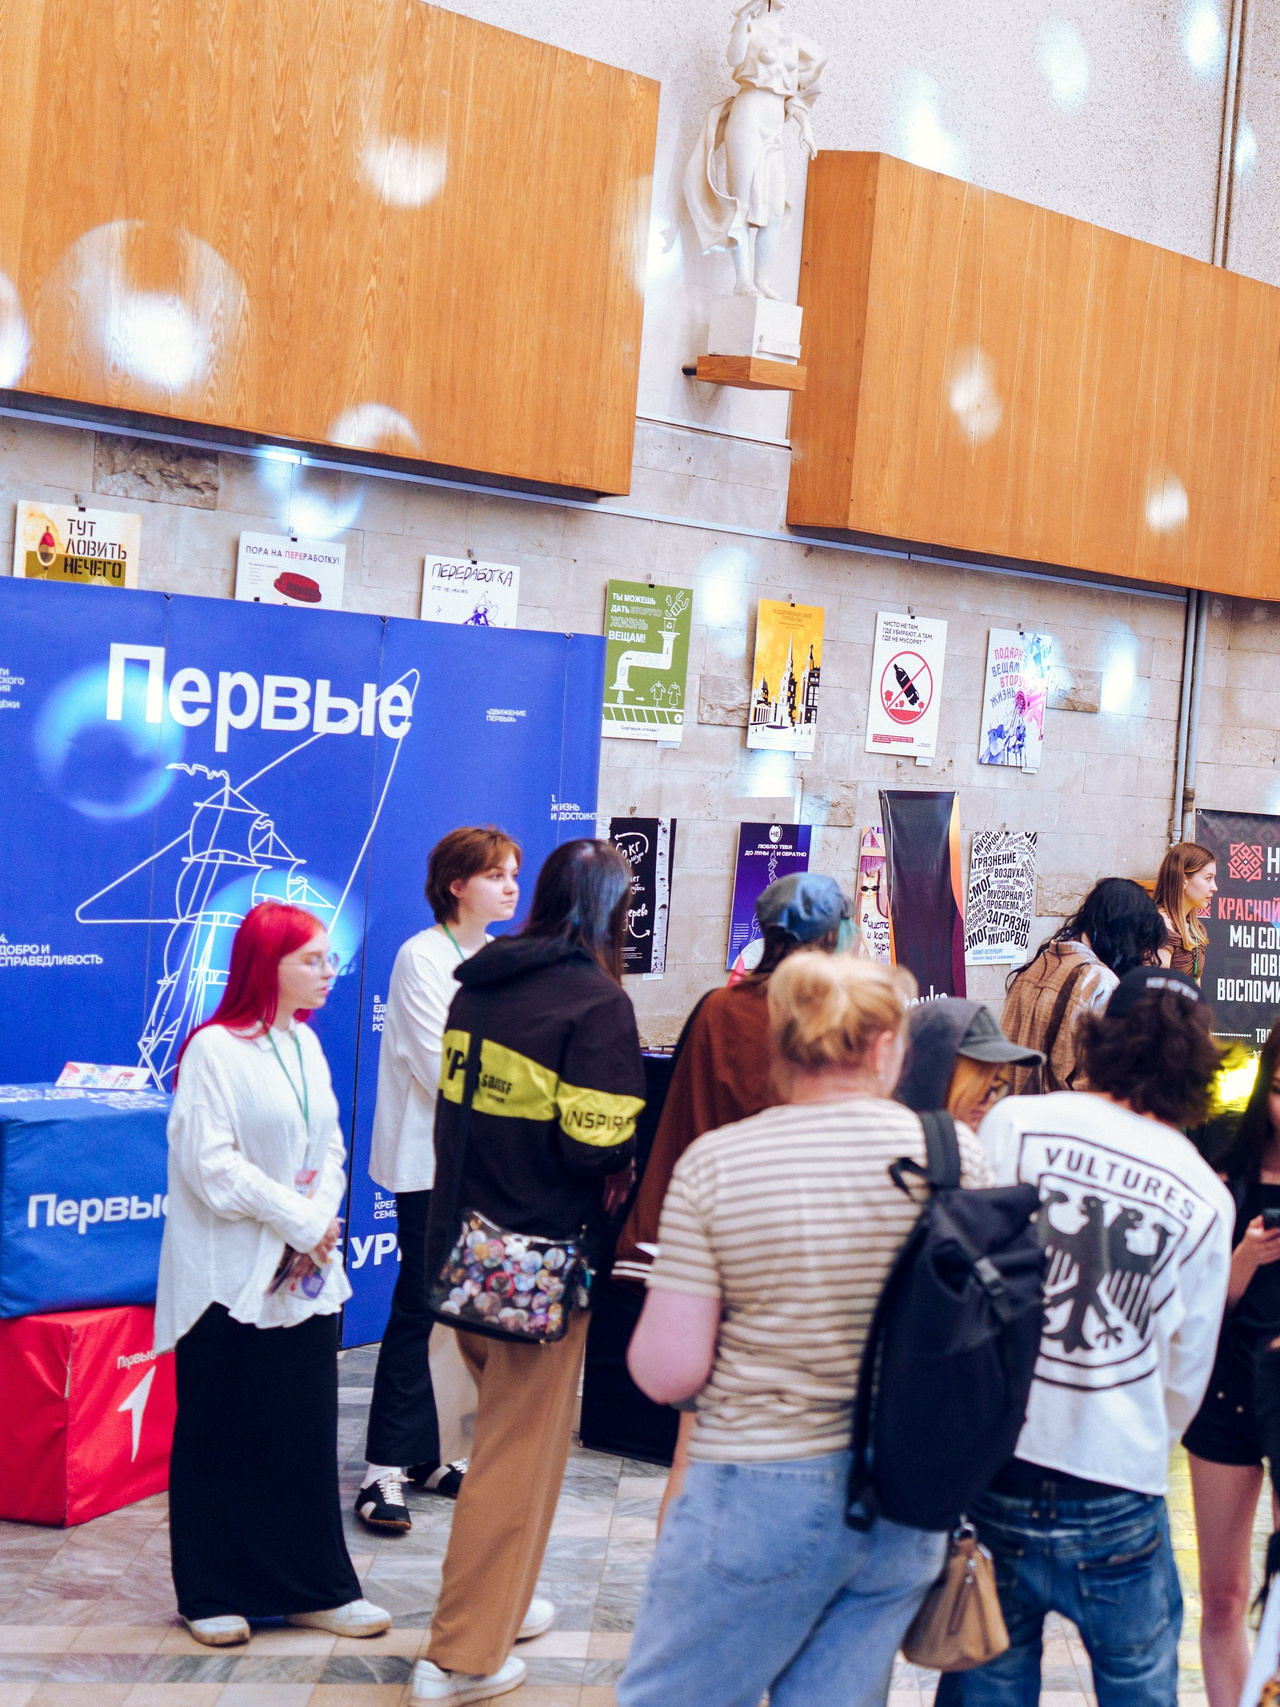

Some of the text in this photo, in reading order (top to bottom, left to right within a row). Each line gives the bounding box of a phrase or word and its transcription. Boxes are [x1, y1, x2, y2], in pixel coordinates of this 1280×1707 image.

[67, 518, 96, 537] ТУТ
[66, 538, 127, 560] ЛОВИТЬ
[246, 545, 340, 565] ПОРА НА ПЕРЕРАБОТКУ!
[63, 557, 122, 579] НЕЧЕГО
[432, 563, 513, 588] ПЕРЕРАБОТКА
[612, 592, 656, 605] ТЫ МОЖЕШЬ
[610, 604, 662, 617] ДАТЬ ВТОРУЮ
[610, 616, 649, 631] ЖИЗНЬ
[608, 630, 646, 643] ВЕЩАМ!
[899, 637, 922, 645] МУСОРЯТ
[991, 661, 1020, 678] ВЕЩАМ
[1000, 674, 1027, 689] ВТОРУ
[106, 642, 413, 754] Первые
[990, 687, 1016, 708] ЖИЗНЬ
[551, 803, 580, 811] ЖИЗНЬ
[551, 812, 557, 820] И
[994, 868, 1024, 879] ВОЗДУХА
[986, 890, 1023, 900] МУСОРНАЯ
[986, 900, 1019, 910] ПРОБЛЕМА
[1218, 896, 1280, 923] КРАСНОЙ
[1229, 924, 1254, 949] МЫ
[0, 944, 50, 956] ДОБРО И
[0, 954, 103, 967] СПРАВЕДЛИВОСТЬ
[1046, 1147, 1196, 1220] VULTURES
